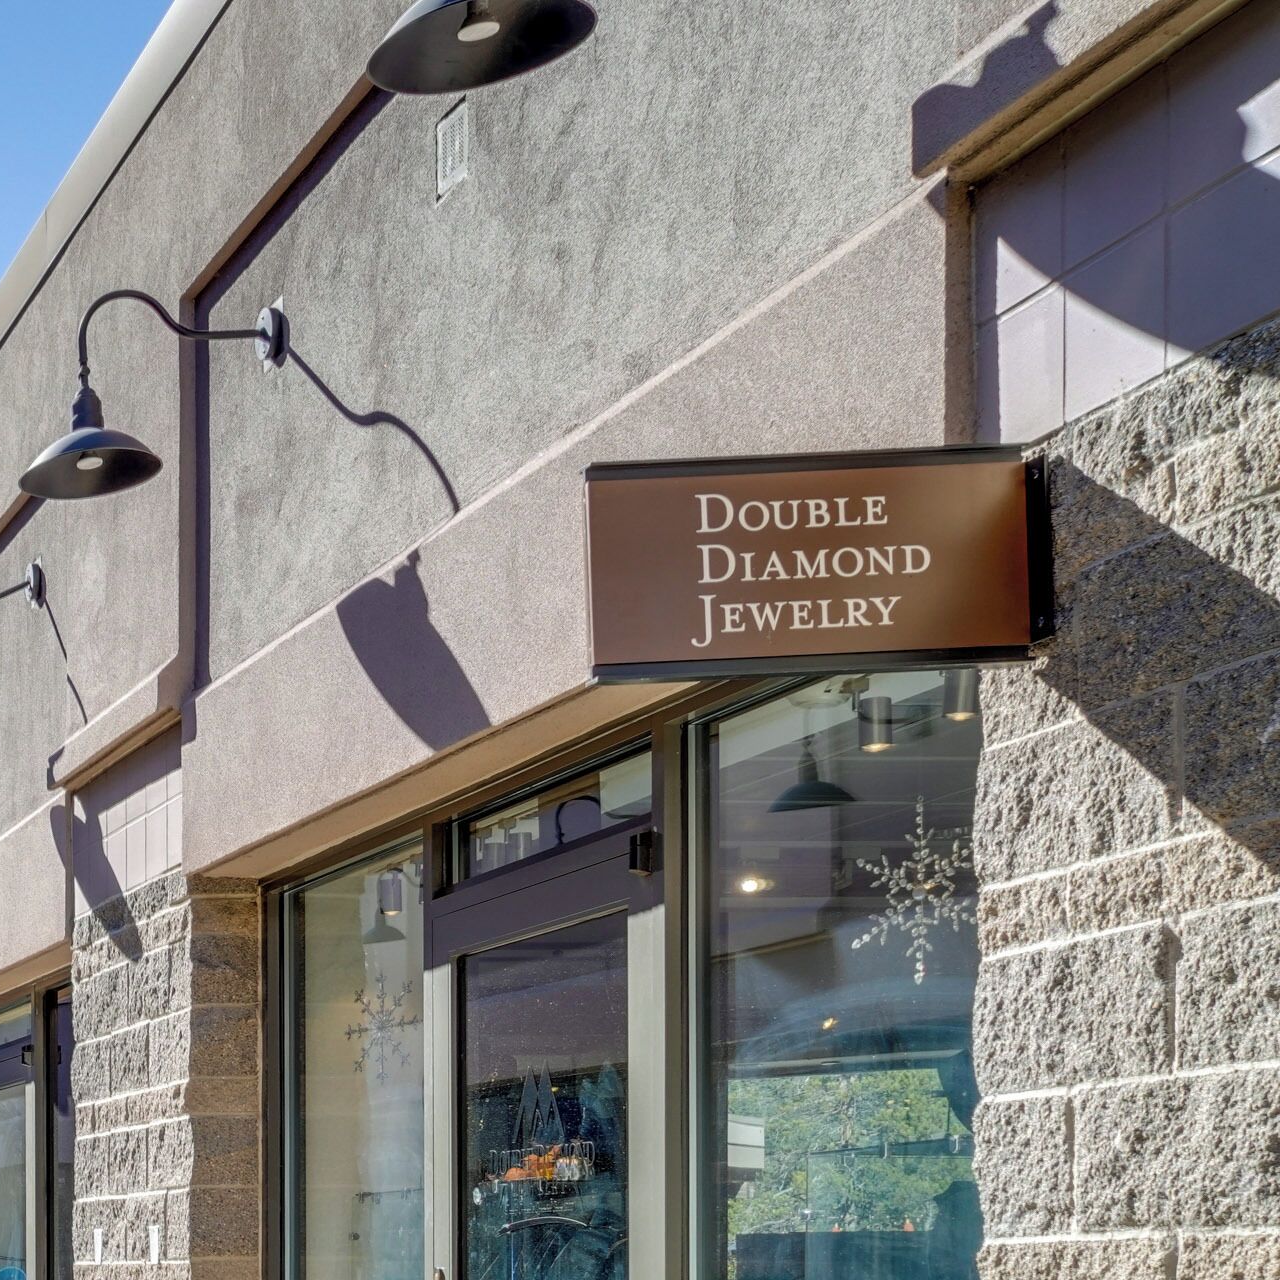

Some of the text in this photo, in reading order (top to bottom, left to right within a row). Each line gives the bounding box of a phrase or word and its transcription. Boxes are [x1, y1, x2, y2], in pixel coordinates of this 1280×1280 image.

[694, 494, 889, 534] DOUBLE
[696, 544, 931, 584] DIAMOND
[691, 594, 903, 647] JEWELRY
